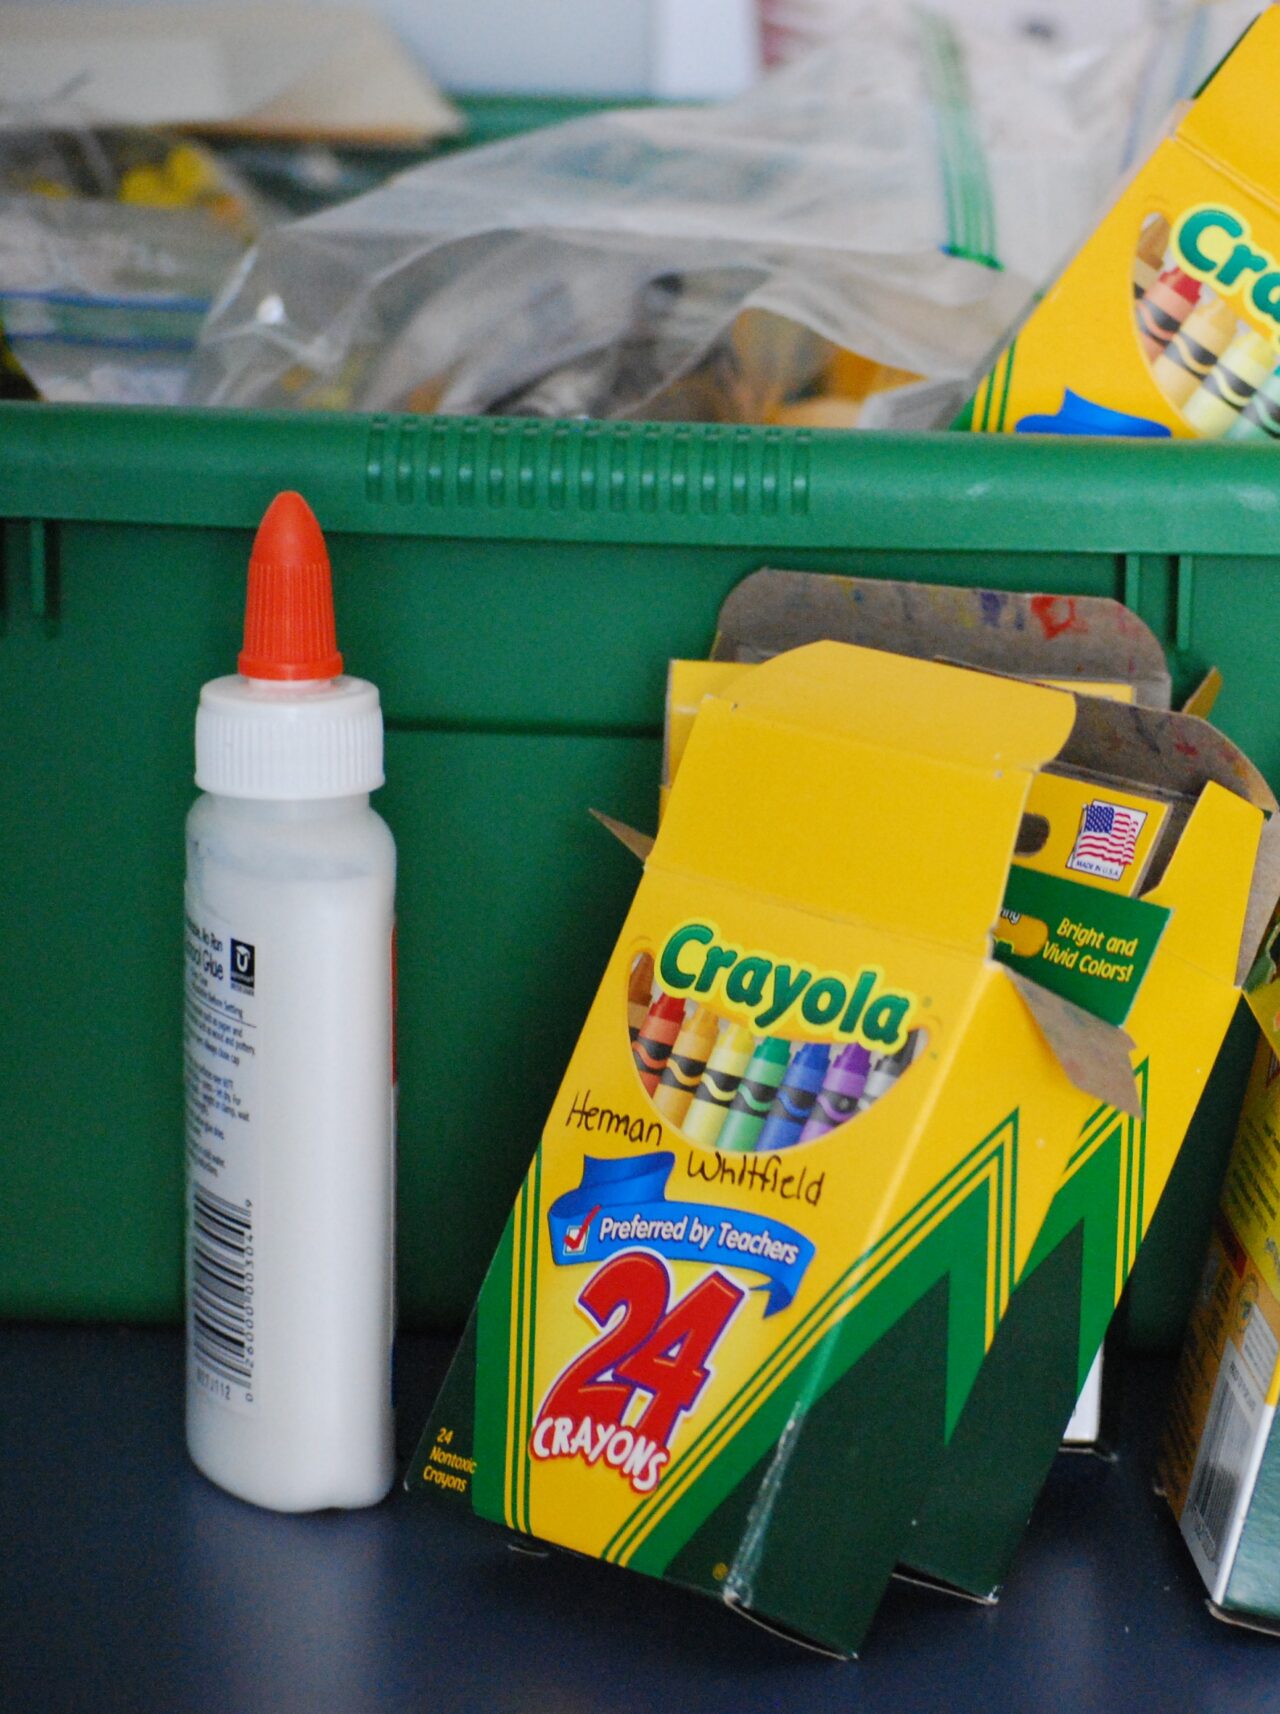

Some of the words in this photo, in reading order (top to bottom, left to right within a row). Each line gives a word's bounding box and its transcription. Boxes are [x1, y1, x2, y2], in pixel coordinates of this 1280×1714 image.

[1057, 917, 1105, 949] Bright
[1106, 934, 1138, 957] and
[203, 949, 224, 981] Glue
[660, 924, 910, 1044] Crayola
[1042, 941, 1079, 969] Vivid
[1079, 954, 1134, 983] Colors!
[565, 1090, 663, 1147] Herman
[687, 1150, 825, 1207] Whitfield
[599, 1216, 688, 1241] Preferred
[689, 1221, 714, 1248] by
[716, 1221, 800, 1264] Teachers
[535, 1248, 747, 1449] 24
[436, 1427, 453, 1446] 24
[531, 1415, 669, 1493] CRAYONS
[422, 1464, 468, 1494] Crayons
[428, 1445, 477, 1476] Nontoxic
